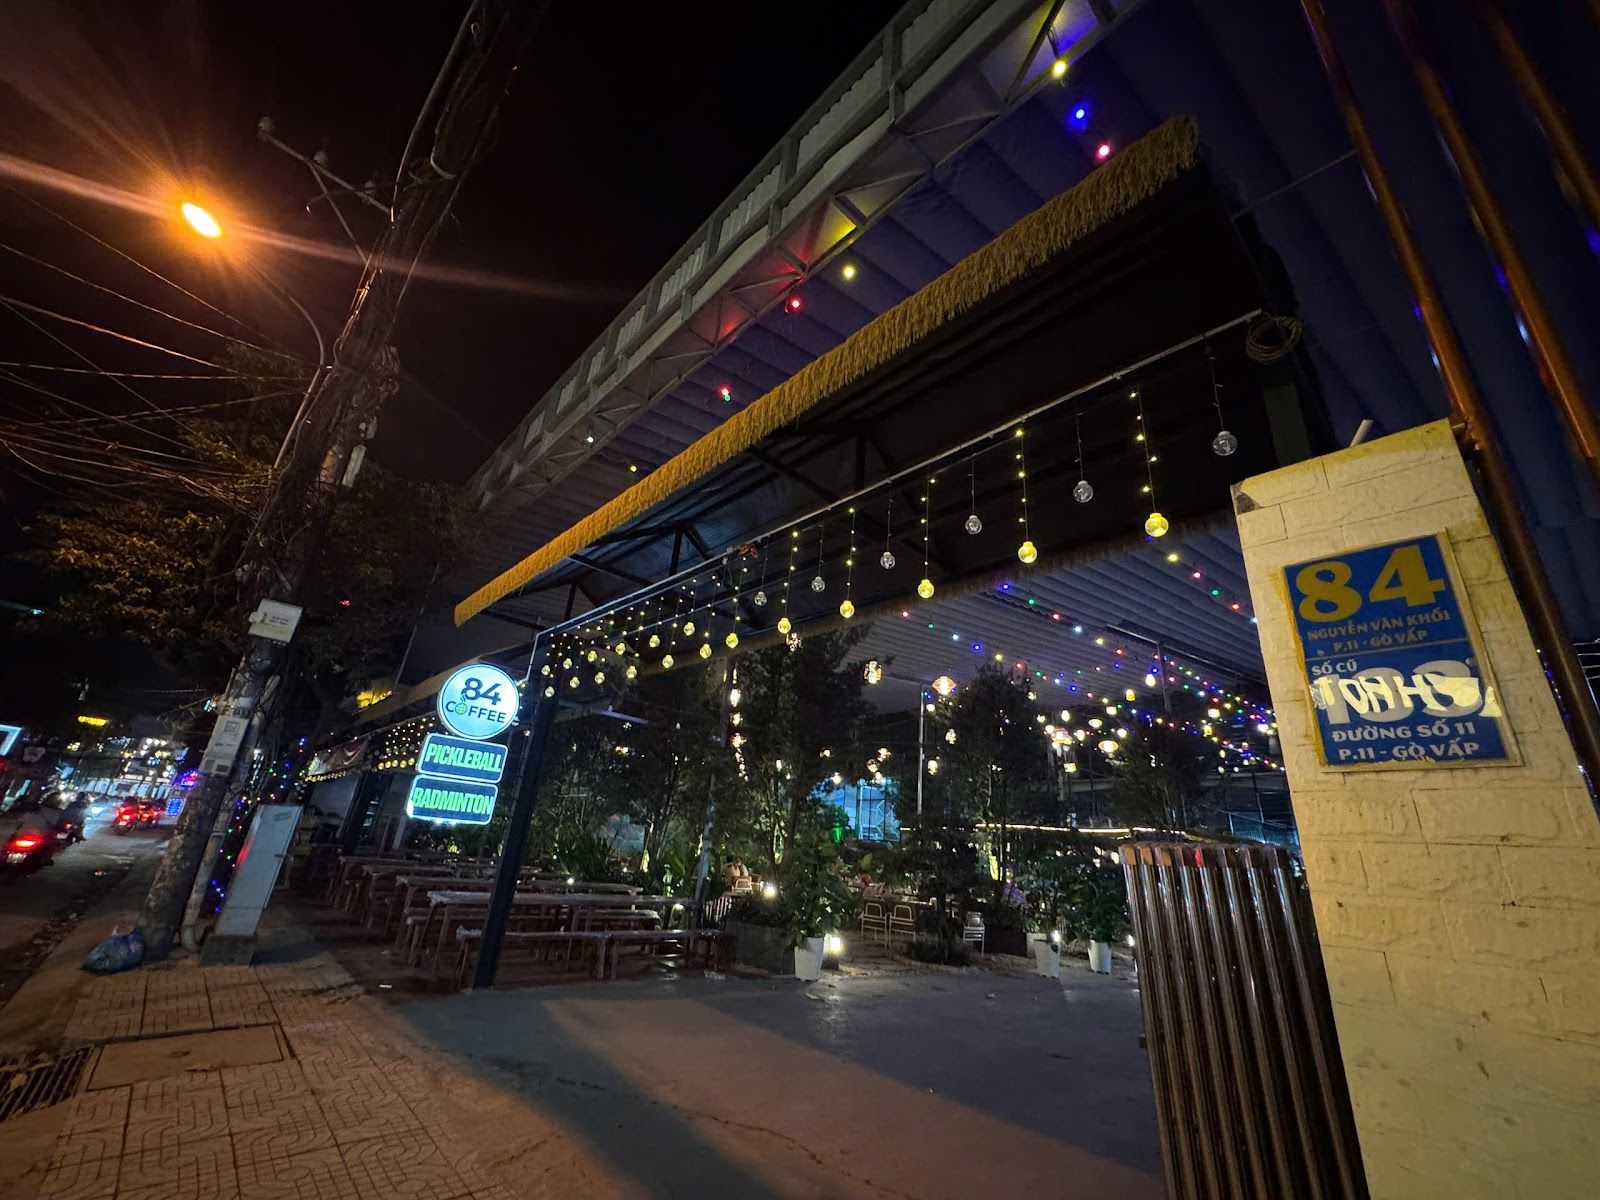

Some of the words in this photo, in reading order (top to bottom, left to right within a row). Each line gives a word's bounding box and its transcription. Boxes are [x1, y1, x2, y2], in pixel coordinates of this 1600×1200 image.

[1295, 544, 1446, 623] 84
[1406, 607, 1450, 627] KHỐI
[1332, 638, 1359, 652] P.11
[1370, 634, 1393, 648] GÒ
[1395, 627, 1428, 643] VẤP
[1311, 660, 1333, 676] SỐ
[1335, 658, 1358, 673] CŨ
[461, 677, 502, 706] 84
[445, 700, 507, 723] COFFEE
[1331, 725, 1412, 743] ĐƯỜNG
[1416, 718, 1451, 739] SỐ
[1454, 721, 1477, 735] 11
[424, 743, 503, 773] PICKLEBALL
[1338, 747, 1375, 761] P.11
[1392, 741, 1426, 759] GÒ
[1429, 737, 1480, 757] VẤP
[412, 787, 495, 815] BADMINTON
